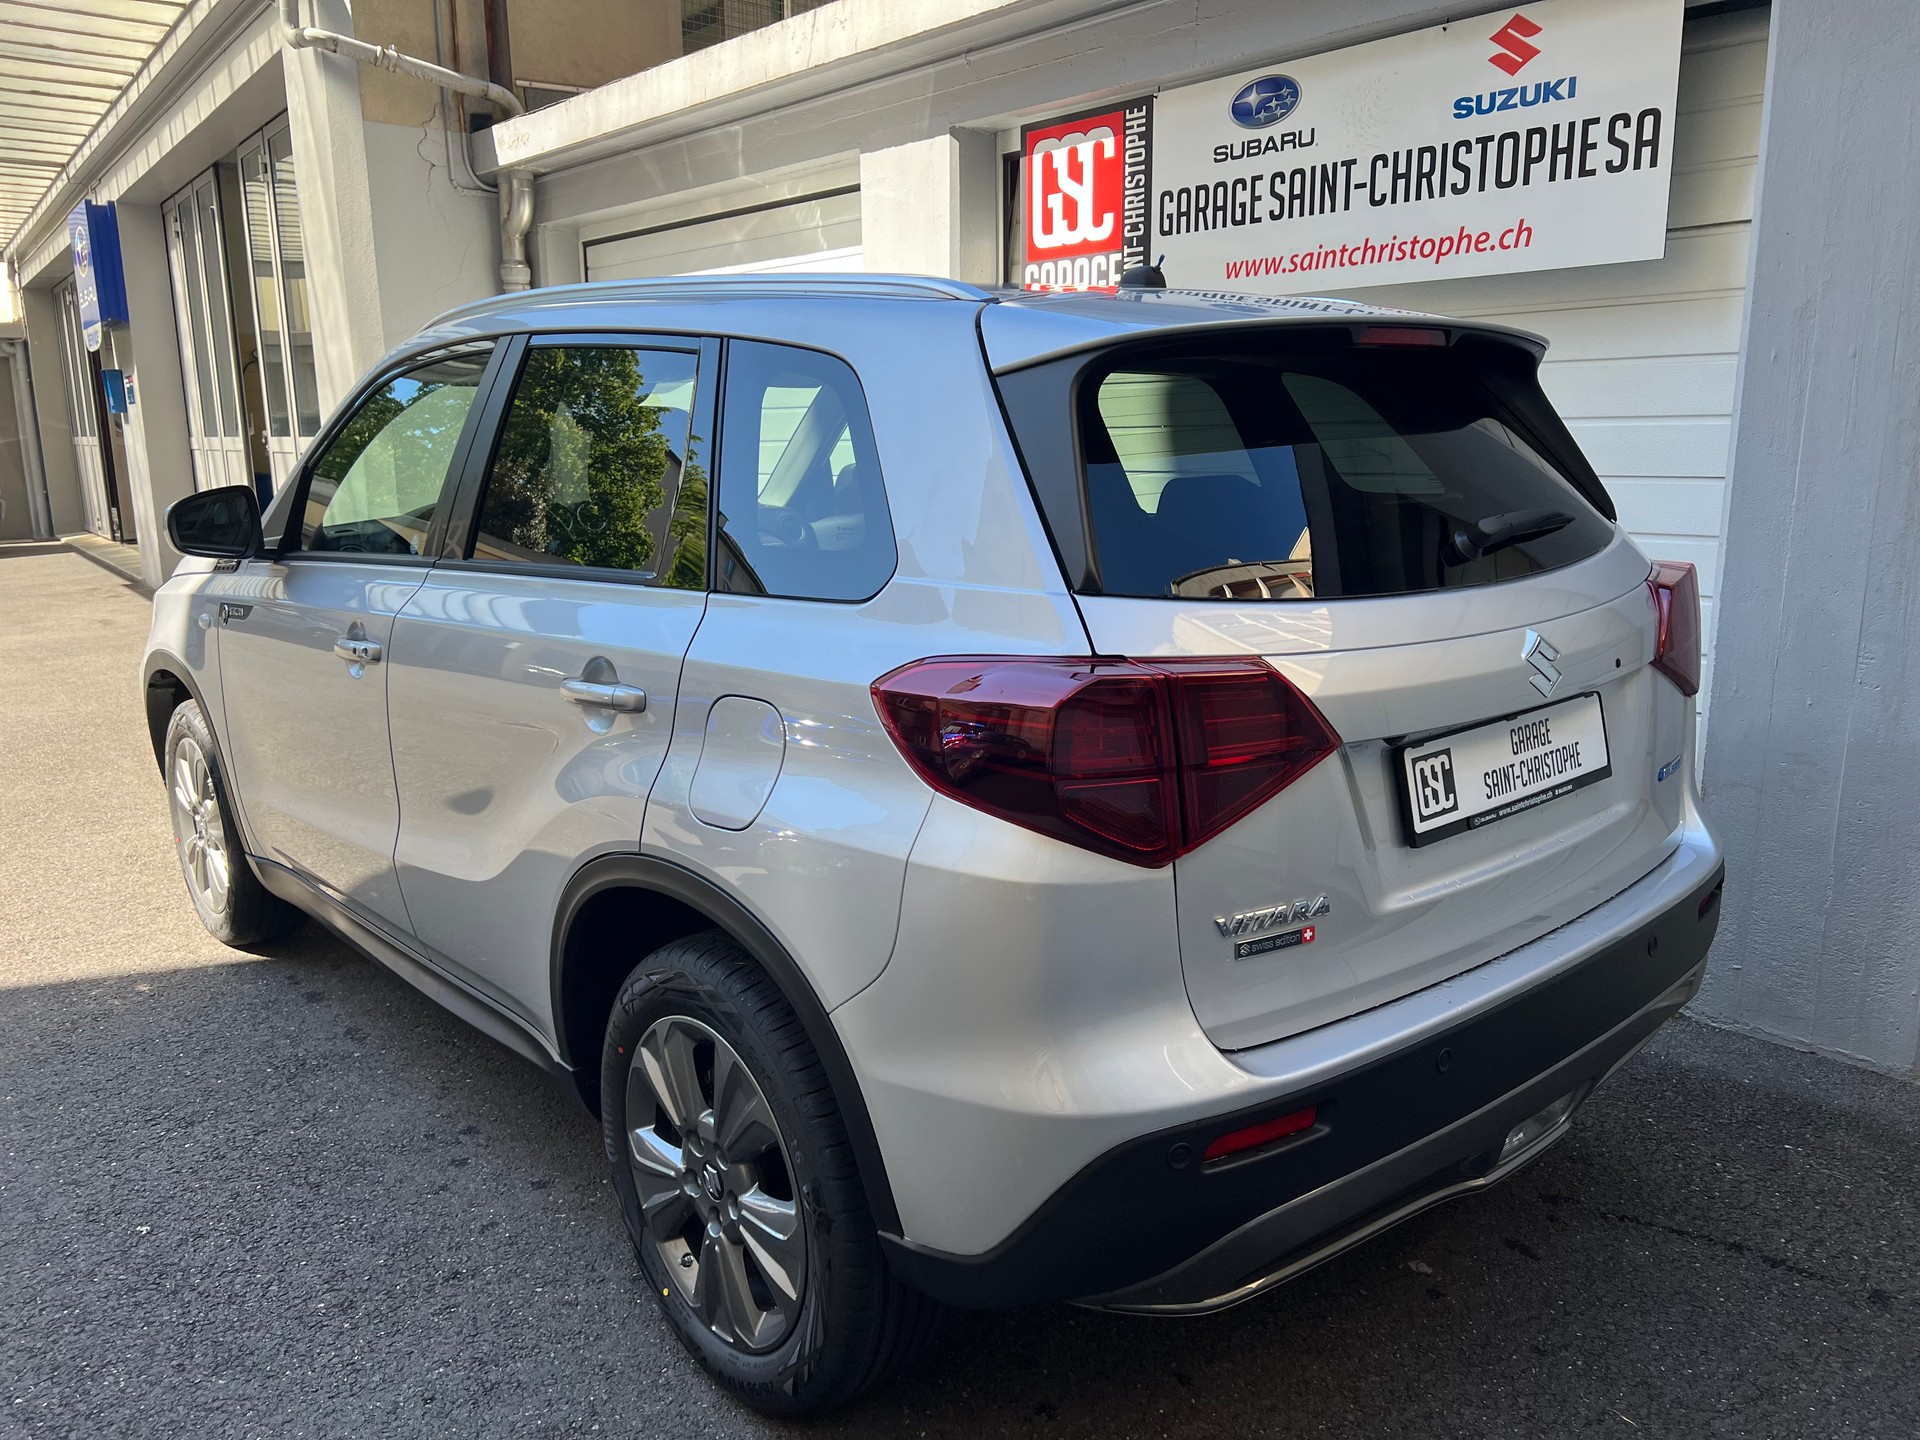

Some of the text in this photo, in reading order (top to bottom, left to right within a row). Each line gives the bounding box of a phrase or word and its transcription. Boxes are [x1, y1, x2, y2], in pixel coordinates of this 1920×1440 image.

[1453, 76, 1577, 119] SUZUKI
[1159, 107, 1662, 237] GARAGE SAINT-CHRISTOPHE SA
[1213, 127, 1316, 164] SUBARU
[1032, 126, 1115, 249] GSC
[1123, 105, 1147, 275] NT-CHRISTOPHE
[1226, 218, 1533, 279] www.saintchristophe.ch
[1509, 718, 1552, 755] GARAGE
[1414, 754, 1454, 817] GSC
[1483, 741, 1582, 800] SAINT-CHRISTOPHE
[1214, 895, 1330, 938] VITARA
[1251, 933, 1301, 952] swiss edition
